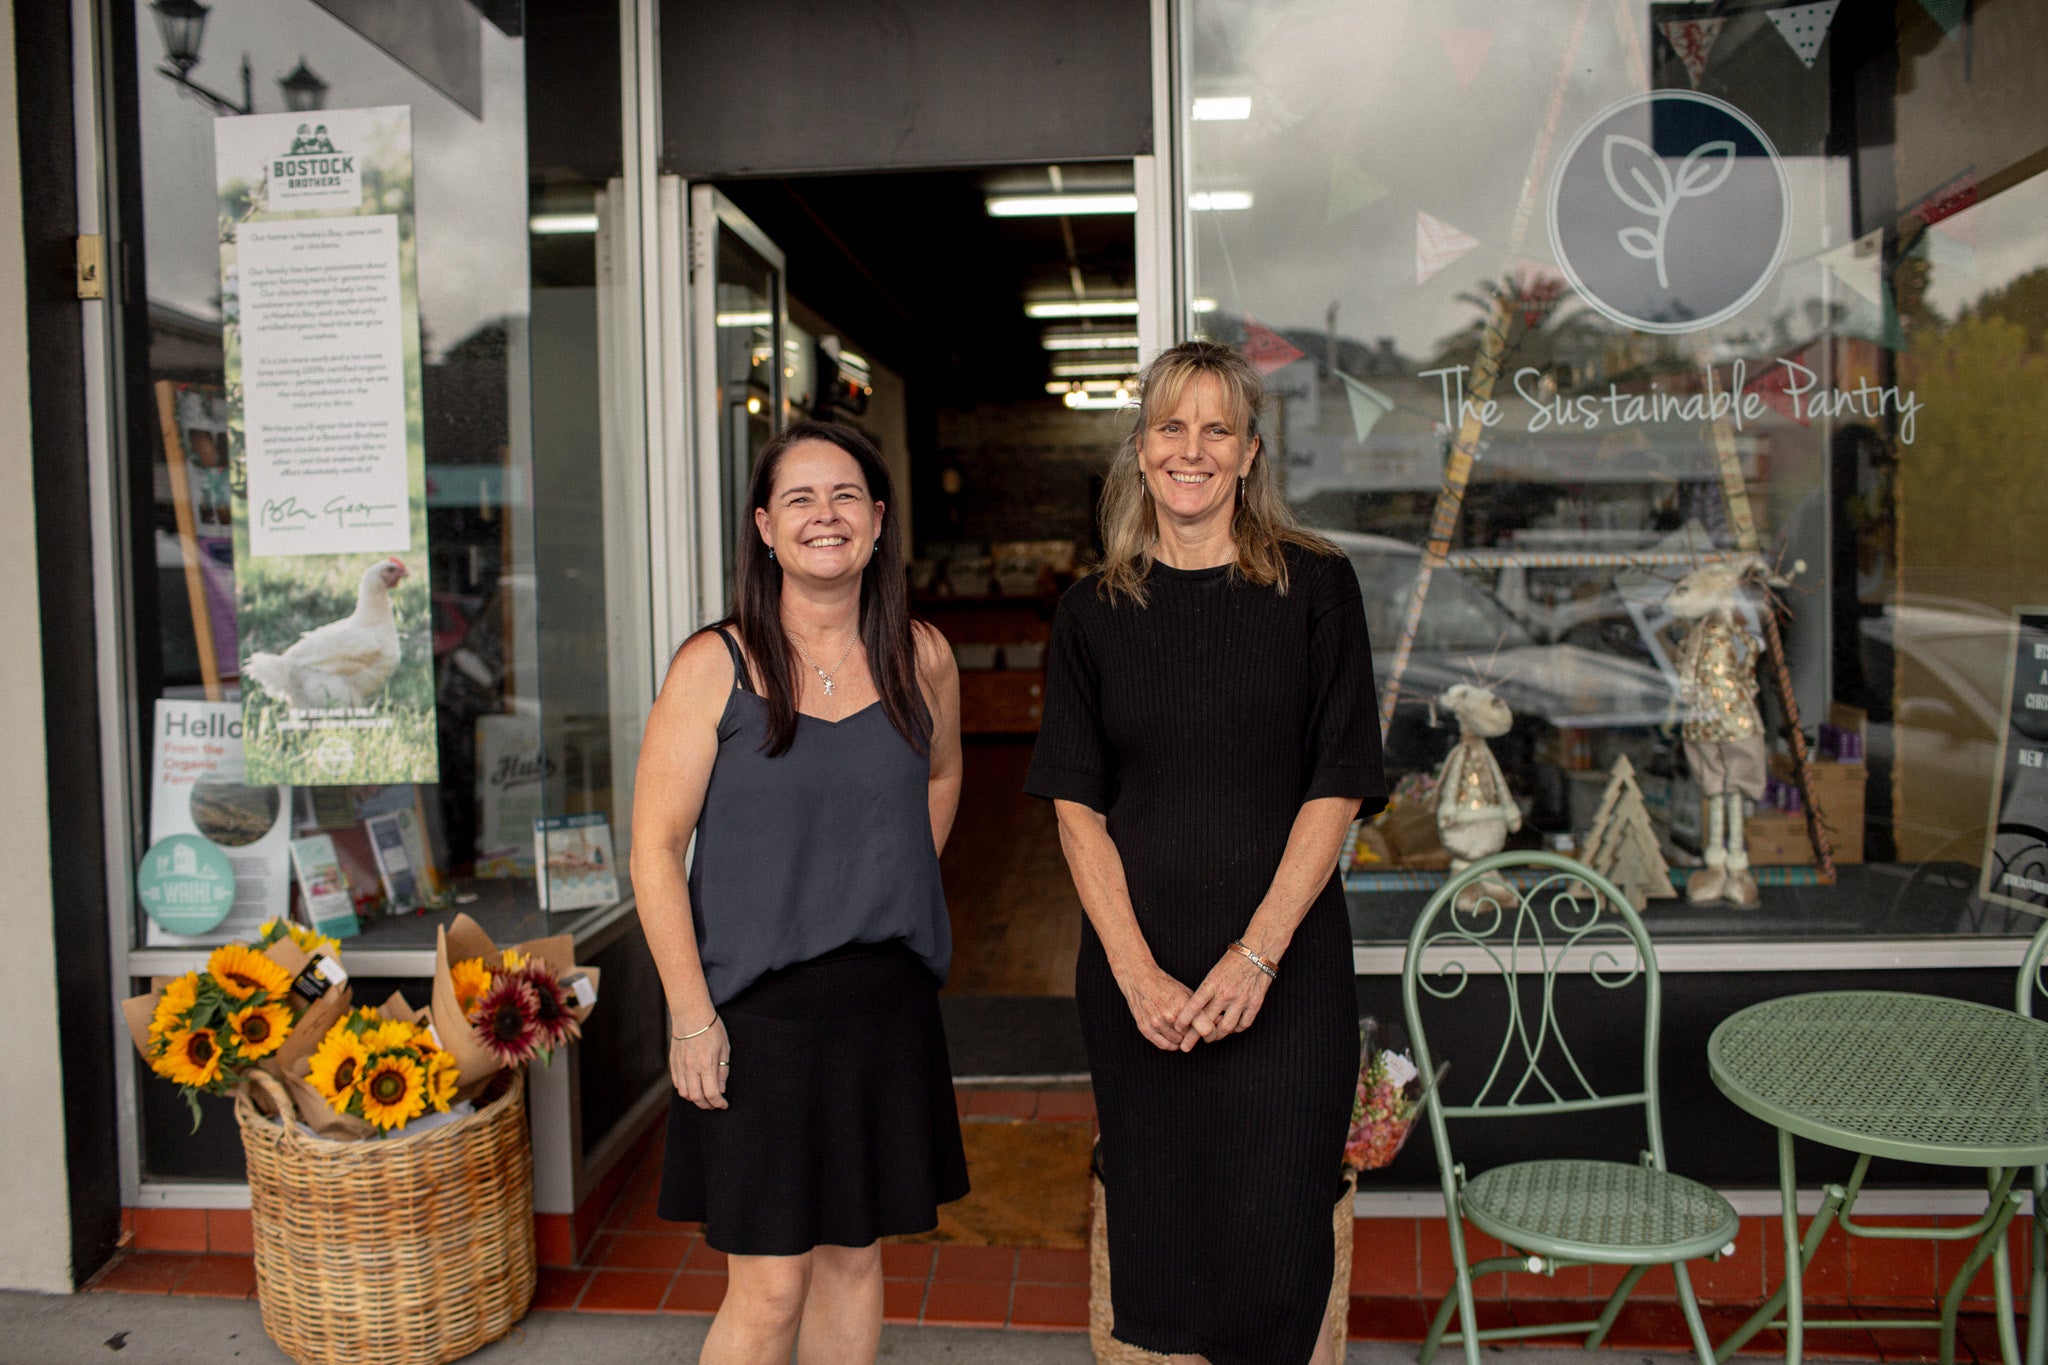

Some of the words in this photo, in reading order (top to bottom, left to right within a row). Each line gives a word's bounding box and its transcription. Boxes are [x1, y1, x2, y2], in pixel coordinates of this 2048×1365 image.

[273, 156, 354, 178] BOSTOCK
[288, 176, 341, 189] BROTHERS
[1418, 365, 1502, 428] The
[1513, 358, 1766, 432] Sustainable
[1776, 357, 1924, 444] Pantry
[165, 712, 243, 739] Hello
[164, 742, 199, 754] From
[203, 743, 225, 756] the
[2019, 748, 2044, 767] NEW
[163, 880, 210, 904] WAIHI
